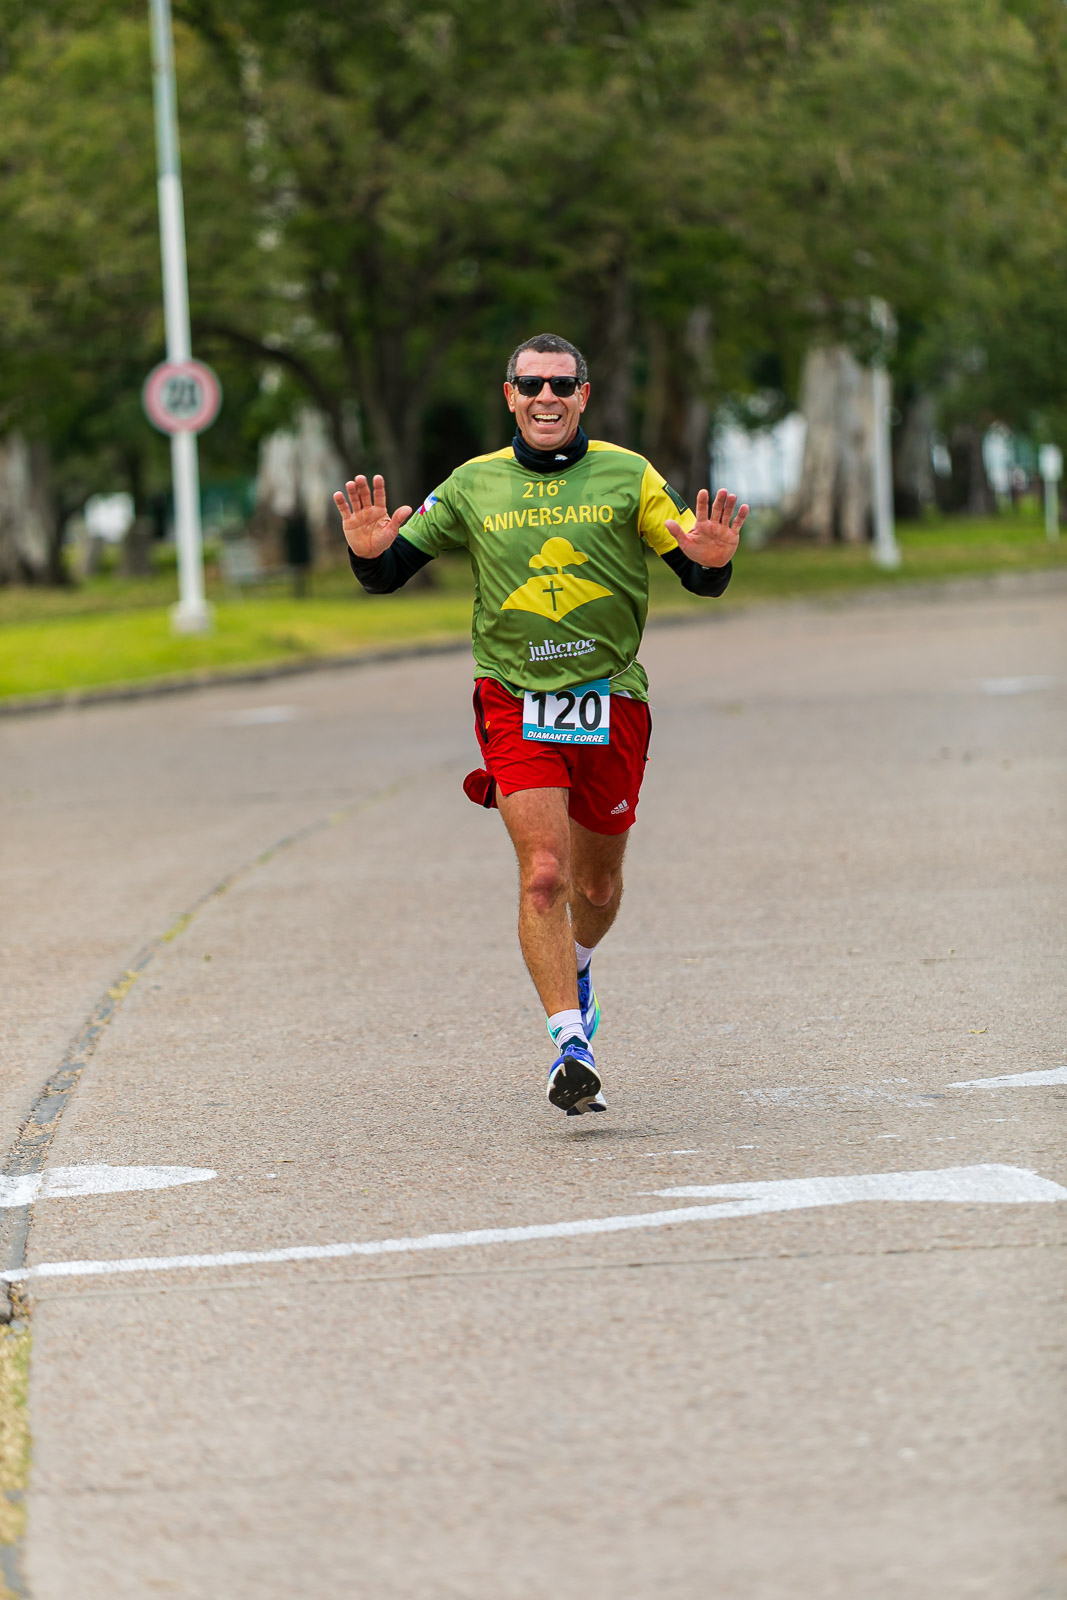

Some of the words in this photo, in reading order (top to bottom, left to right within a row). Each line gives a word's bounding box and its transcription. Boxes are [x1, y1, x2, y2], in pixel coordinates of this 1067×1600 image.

[483, 504, 614, 533] ANIVERSARIO
[528, 638, 596, 662] julicroc
[530, 689, 603, 732] 120
[527, 730, 573, 742] DIAMANTE
[573, 734, 605, 743] CORRE
